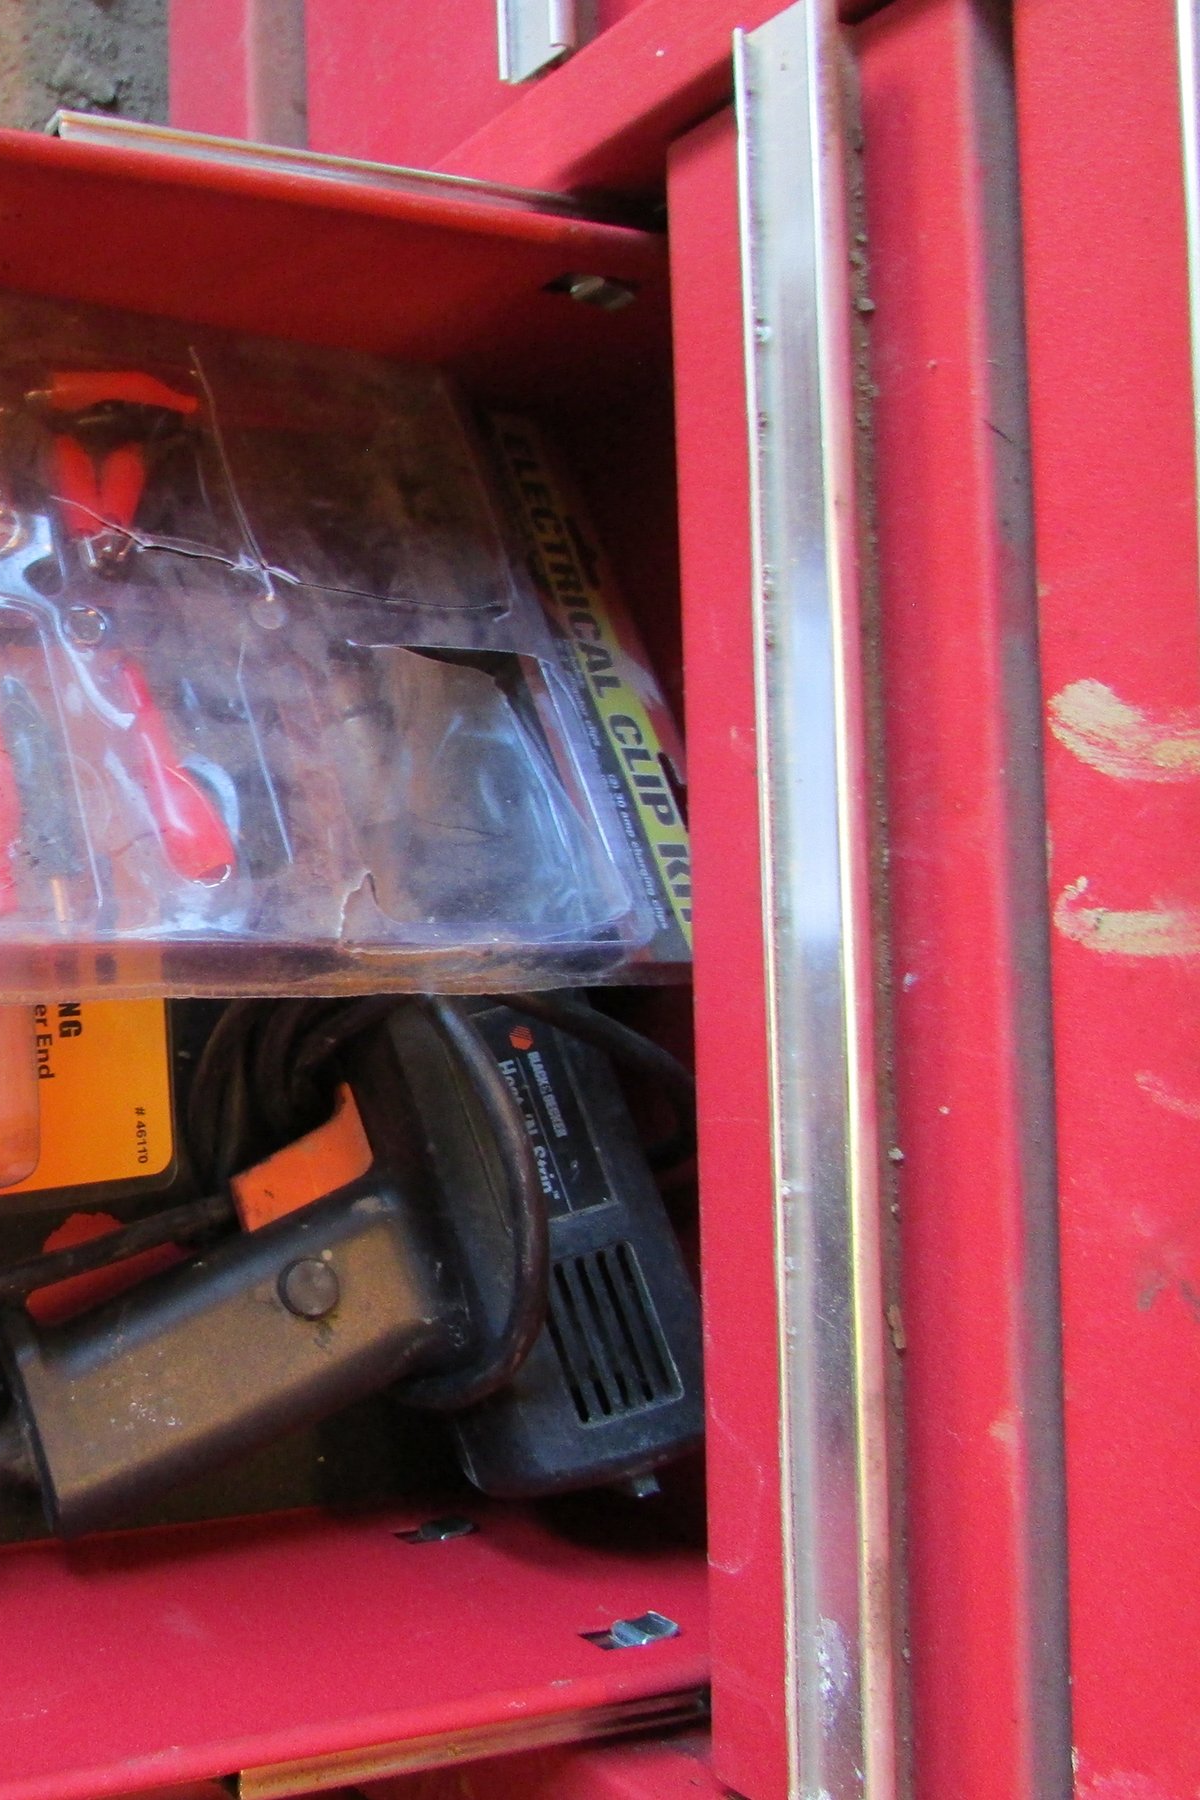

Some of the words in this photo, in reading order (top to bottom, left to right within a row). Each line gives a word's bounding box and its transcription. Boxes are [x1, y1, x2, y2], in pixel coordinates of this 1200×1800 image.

[504, 431, 621, 699] ELECTRICAL
[608, 714, 676, 827] CLIP
[36, 1033, 55, 1079] End
[136, 1120, 148, 1164] 46110
